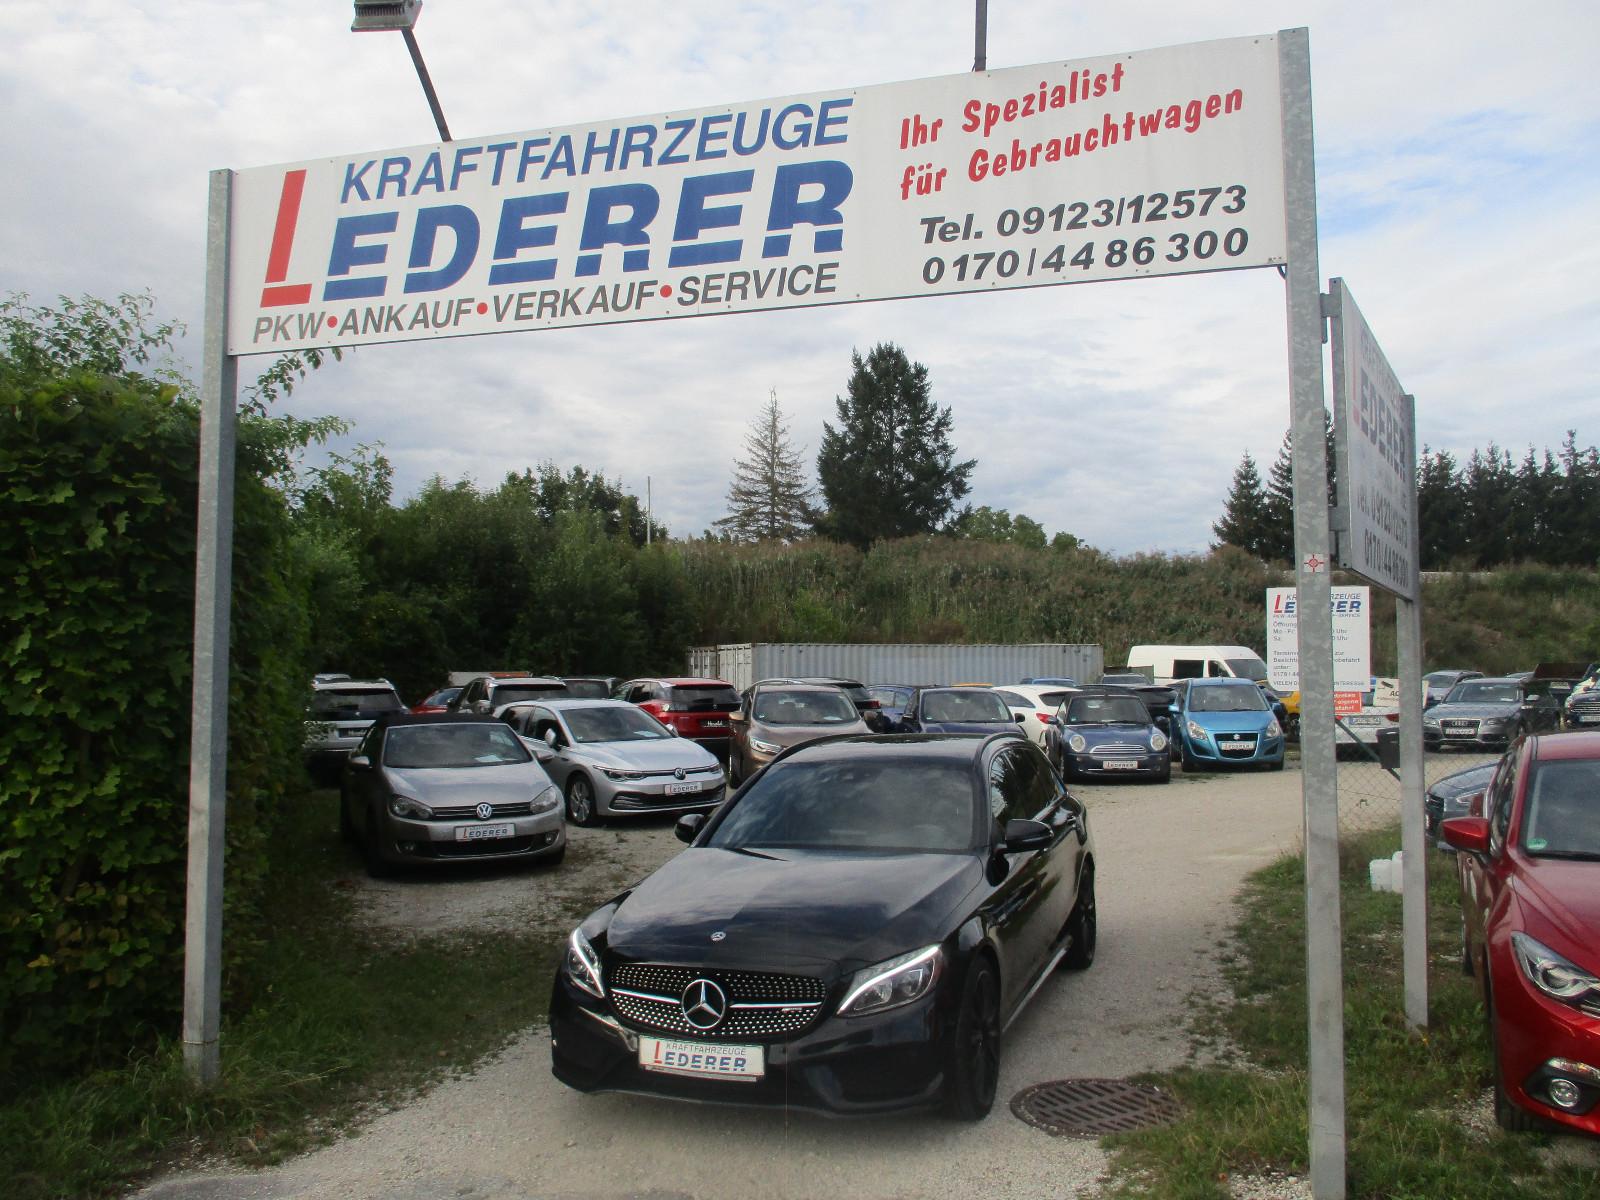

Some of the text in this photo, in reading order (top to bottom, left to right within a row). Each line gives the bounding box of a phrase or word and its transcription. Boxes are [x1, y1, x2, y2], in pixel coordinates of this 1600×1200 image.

[900, 63, 1124, 149] Ihr Spezialist
[900, 89, 1243, 200] für Gebrauchtwagen
[340, 98, 854, 203] KRAFTFAHRZEUGE
[260, 160, 854, 308] LEDERER
[920, 184, 1247, 244] Tel. 09123/12573
[253, 262, 839, 344] PKW ANKAUF VERKAUF SERVICE
[654, 1041, 747, 1072] LEDERER
[665, 1040, 747, 1056] KRAFTFAHRZEUGE
